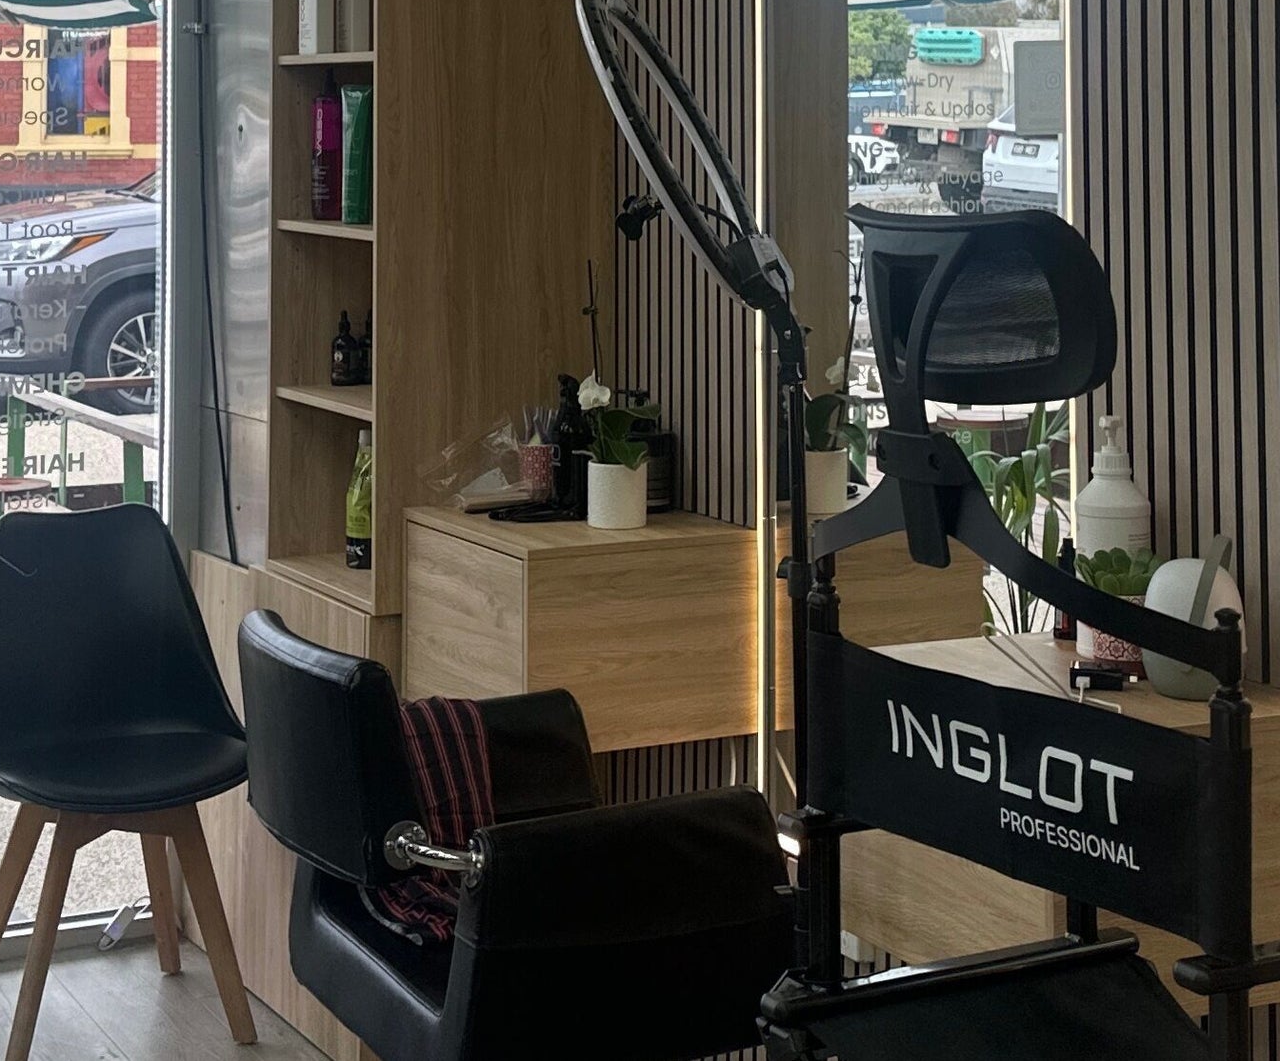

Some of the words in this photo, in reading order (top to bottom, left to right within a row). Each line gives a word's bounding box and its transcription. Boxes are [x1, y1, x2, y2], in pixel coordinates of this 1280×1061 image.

[924, 101, 937, 117] &
[941, 101, 996, 121] Updos
[928, 169, 1004, 190] alayage
[886, 699, 1134, 825] INGLOT
[999, 807, 1141, 872] PROFESSIONAL
